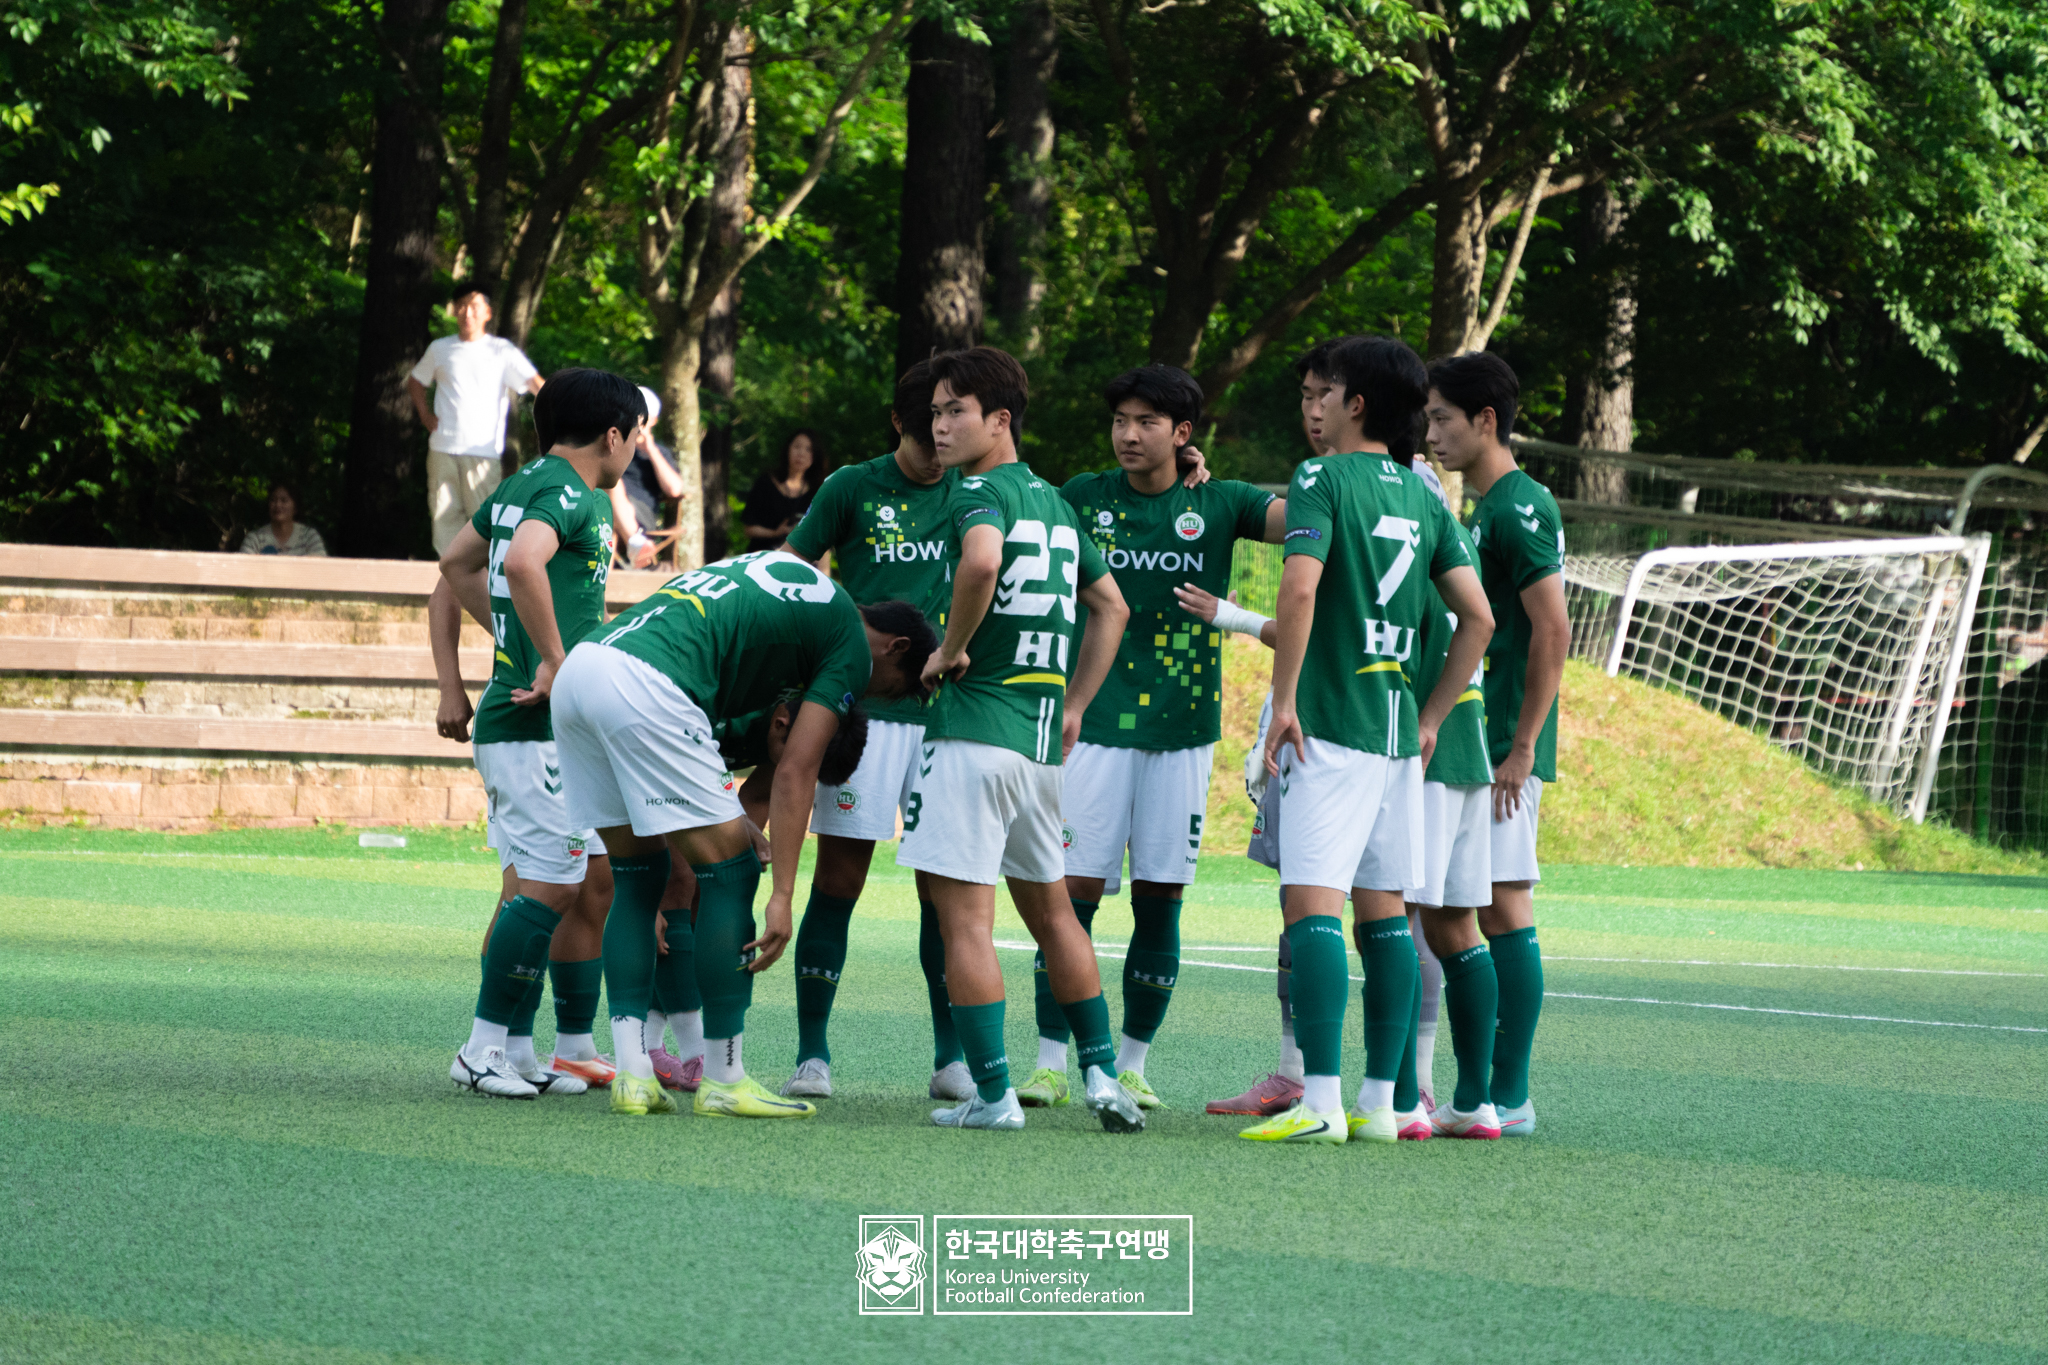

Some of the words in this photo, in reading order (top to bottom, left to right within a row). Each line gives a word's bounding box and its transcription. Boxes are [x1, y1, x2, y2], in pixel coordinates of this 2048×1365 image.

[875, 540, 948, 563] HOW
[1371, 514, 1421, 607] 7
[993, 519, 1080, 624] 23
[665, 570, 740, 600] HU
[1363, 618, 1416, 663] HU
[1186, 856, 1197, 864] hum
[1311, 926, 1345, 939] HOW
[801, 966, 840, 981] HU
[1133, 970, 1175, 986] HU
